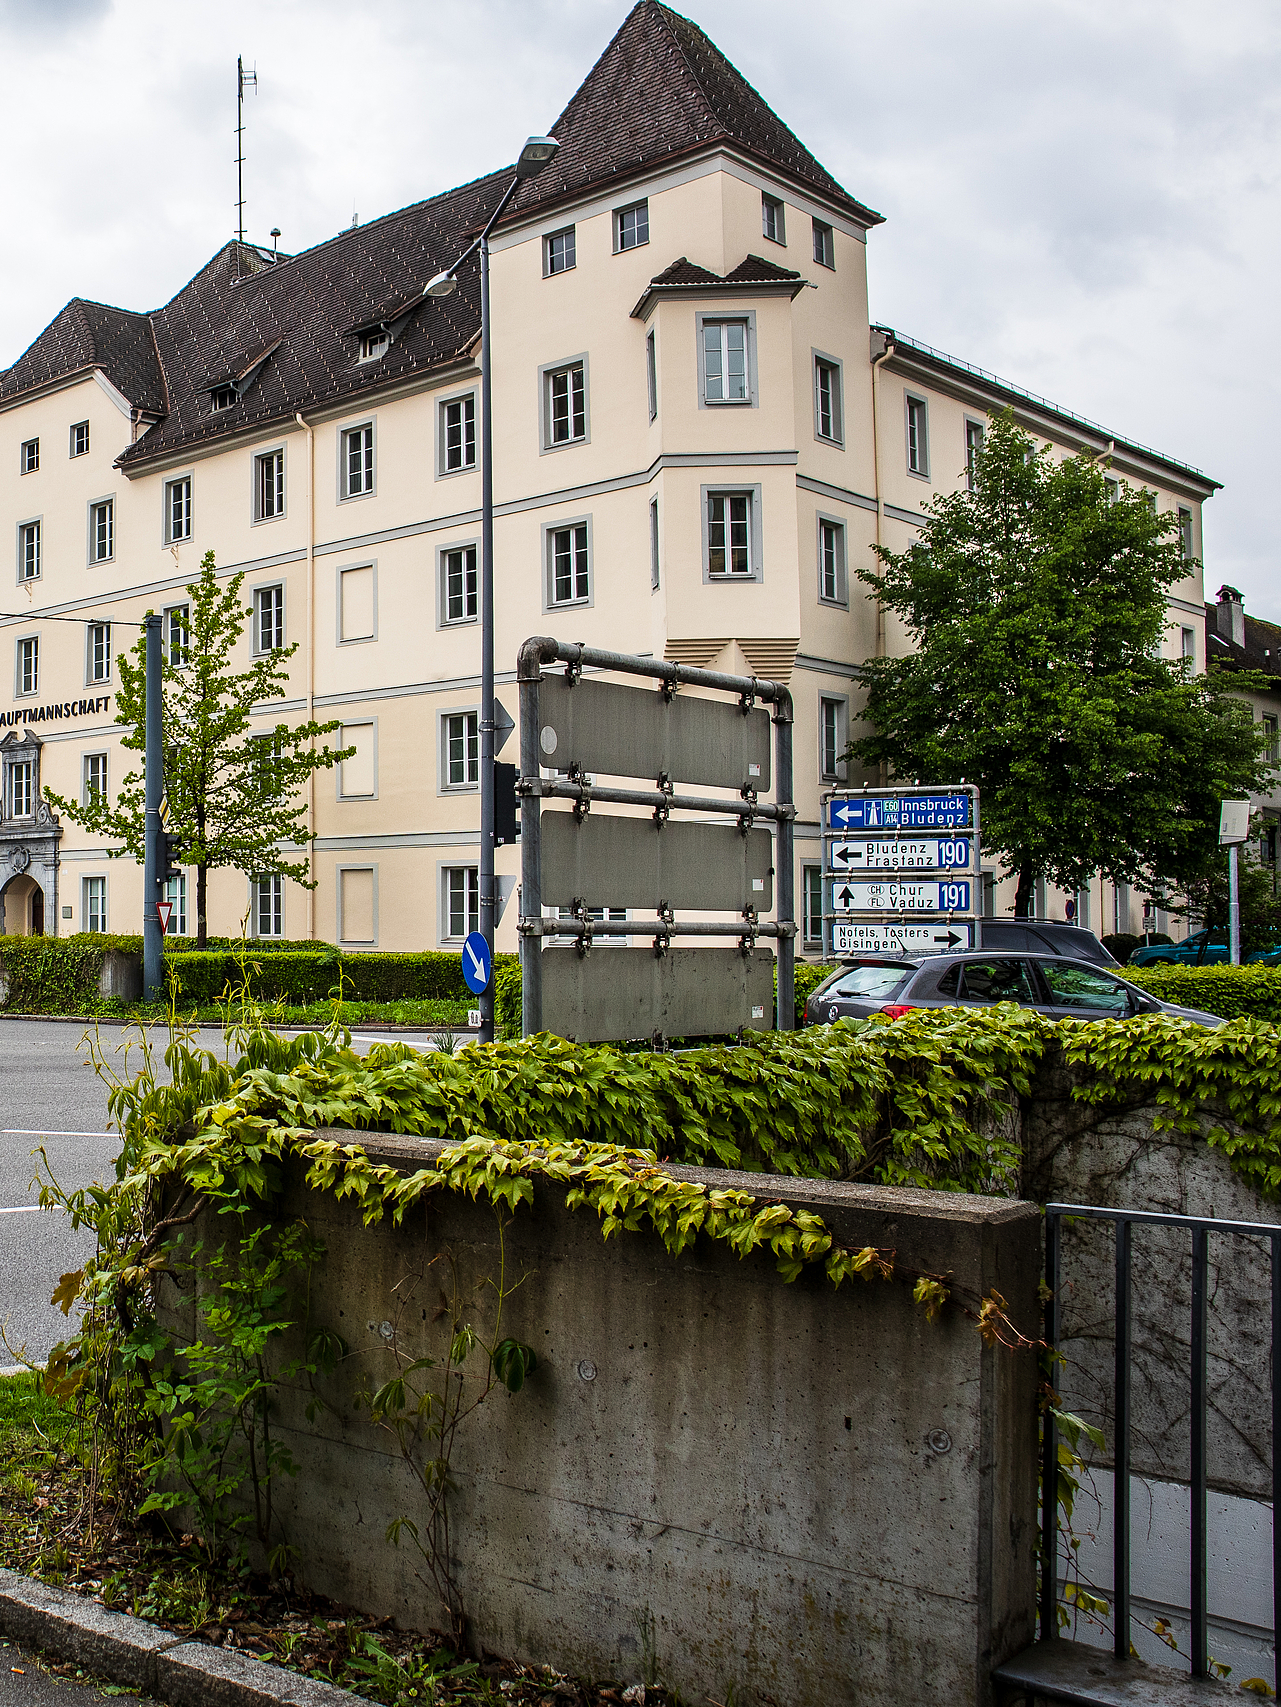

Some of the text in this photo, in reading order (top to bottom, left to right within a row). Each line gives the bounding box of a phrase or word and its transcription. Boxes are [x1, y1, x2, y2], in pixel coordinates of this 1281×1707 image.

[884, 798, 964, 812] E60 Innsbruck
[885, 812, 964, 825] A14 Bludenz
[866, 843, 927, 855] Bludenz
[939, 841, 966, 865] 190
[866, 855, 933, 867] Frastanz
[870, 884, 924, 896] CH Chur
[941, 884, 966, 908] 191
[871, 897, 934, 908] FL Vaduz
[839, 926, 929, 938] Nofels, Tosters
[839, 938, 897, 949] Gisingen
